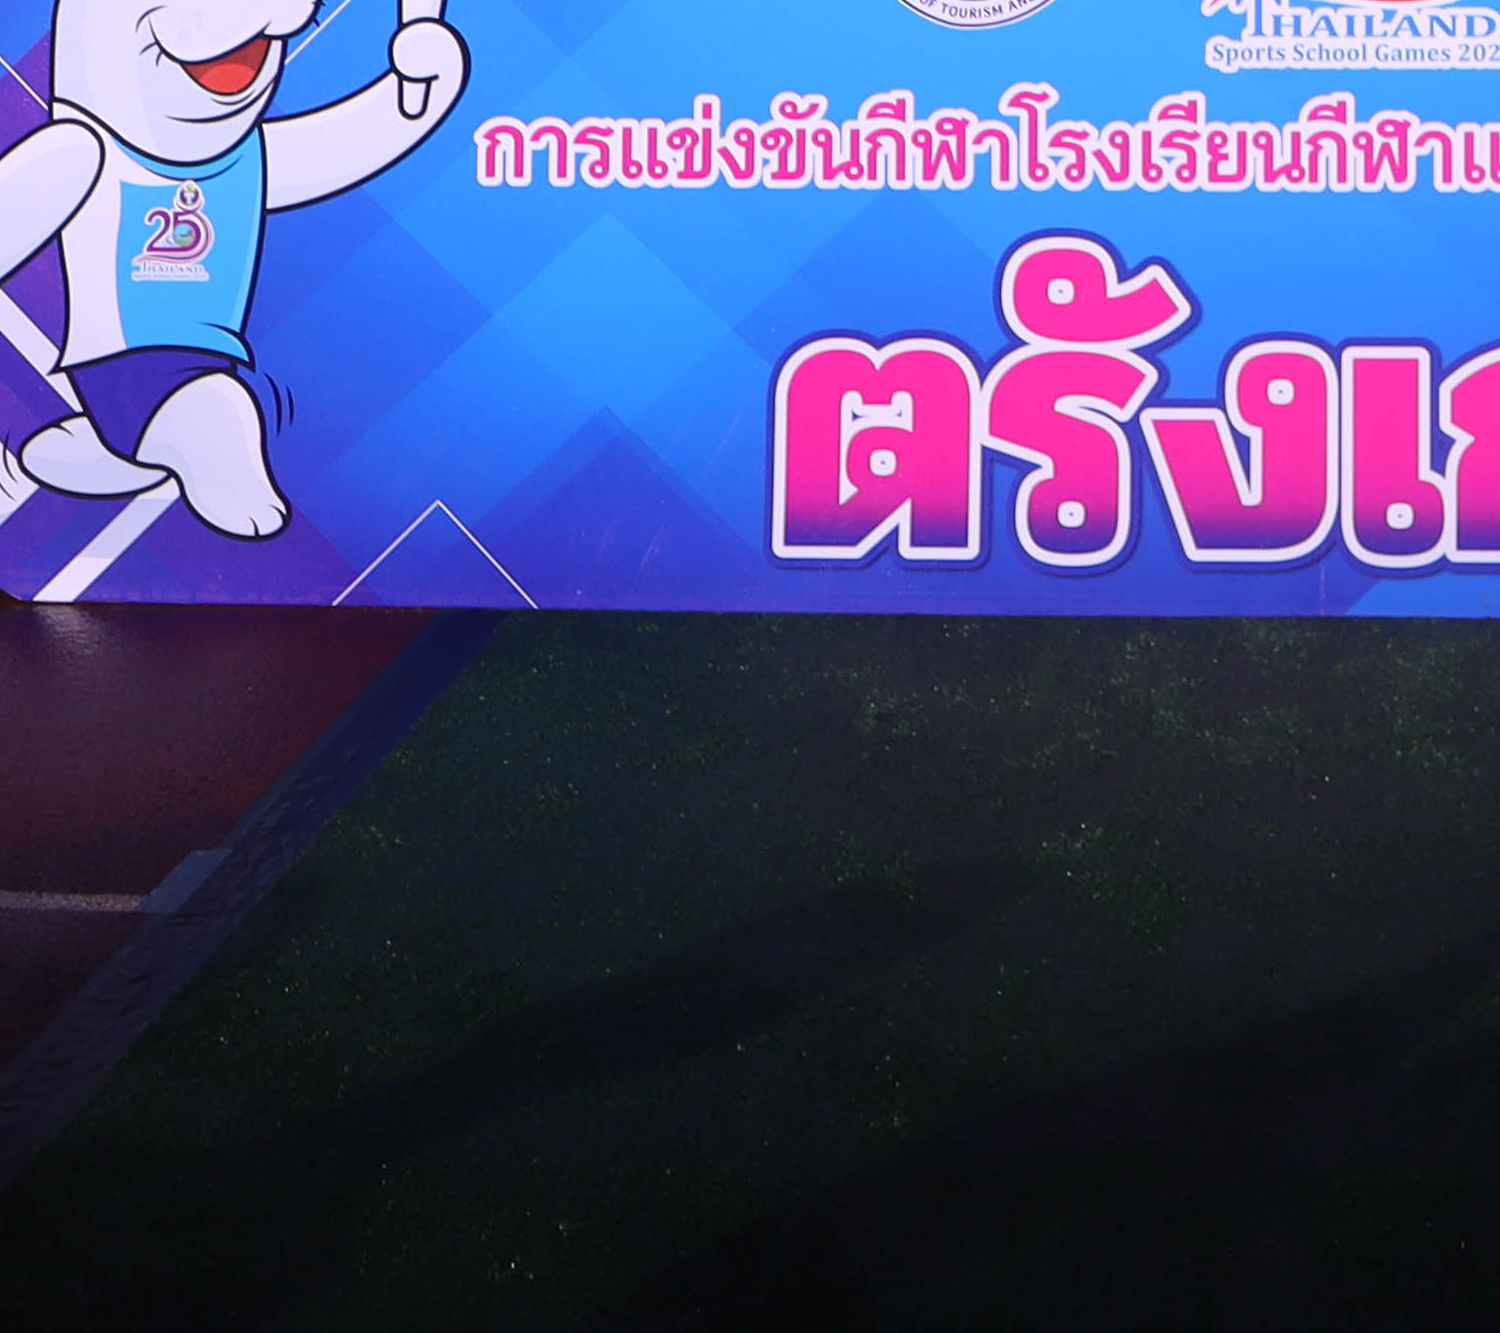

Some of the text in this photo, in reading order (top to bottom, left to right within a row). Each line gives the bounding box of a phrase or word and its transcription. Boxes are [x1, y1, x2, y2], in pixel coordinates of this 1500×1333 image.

[941, 1, 1003, 19] TOURISM
[1211, 42, 1286, 66] Sports
[1292, 41, 1367, 62] School
[1375, 43, 1451, 62] Games
[147, 209, 202, 252] 25
